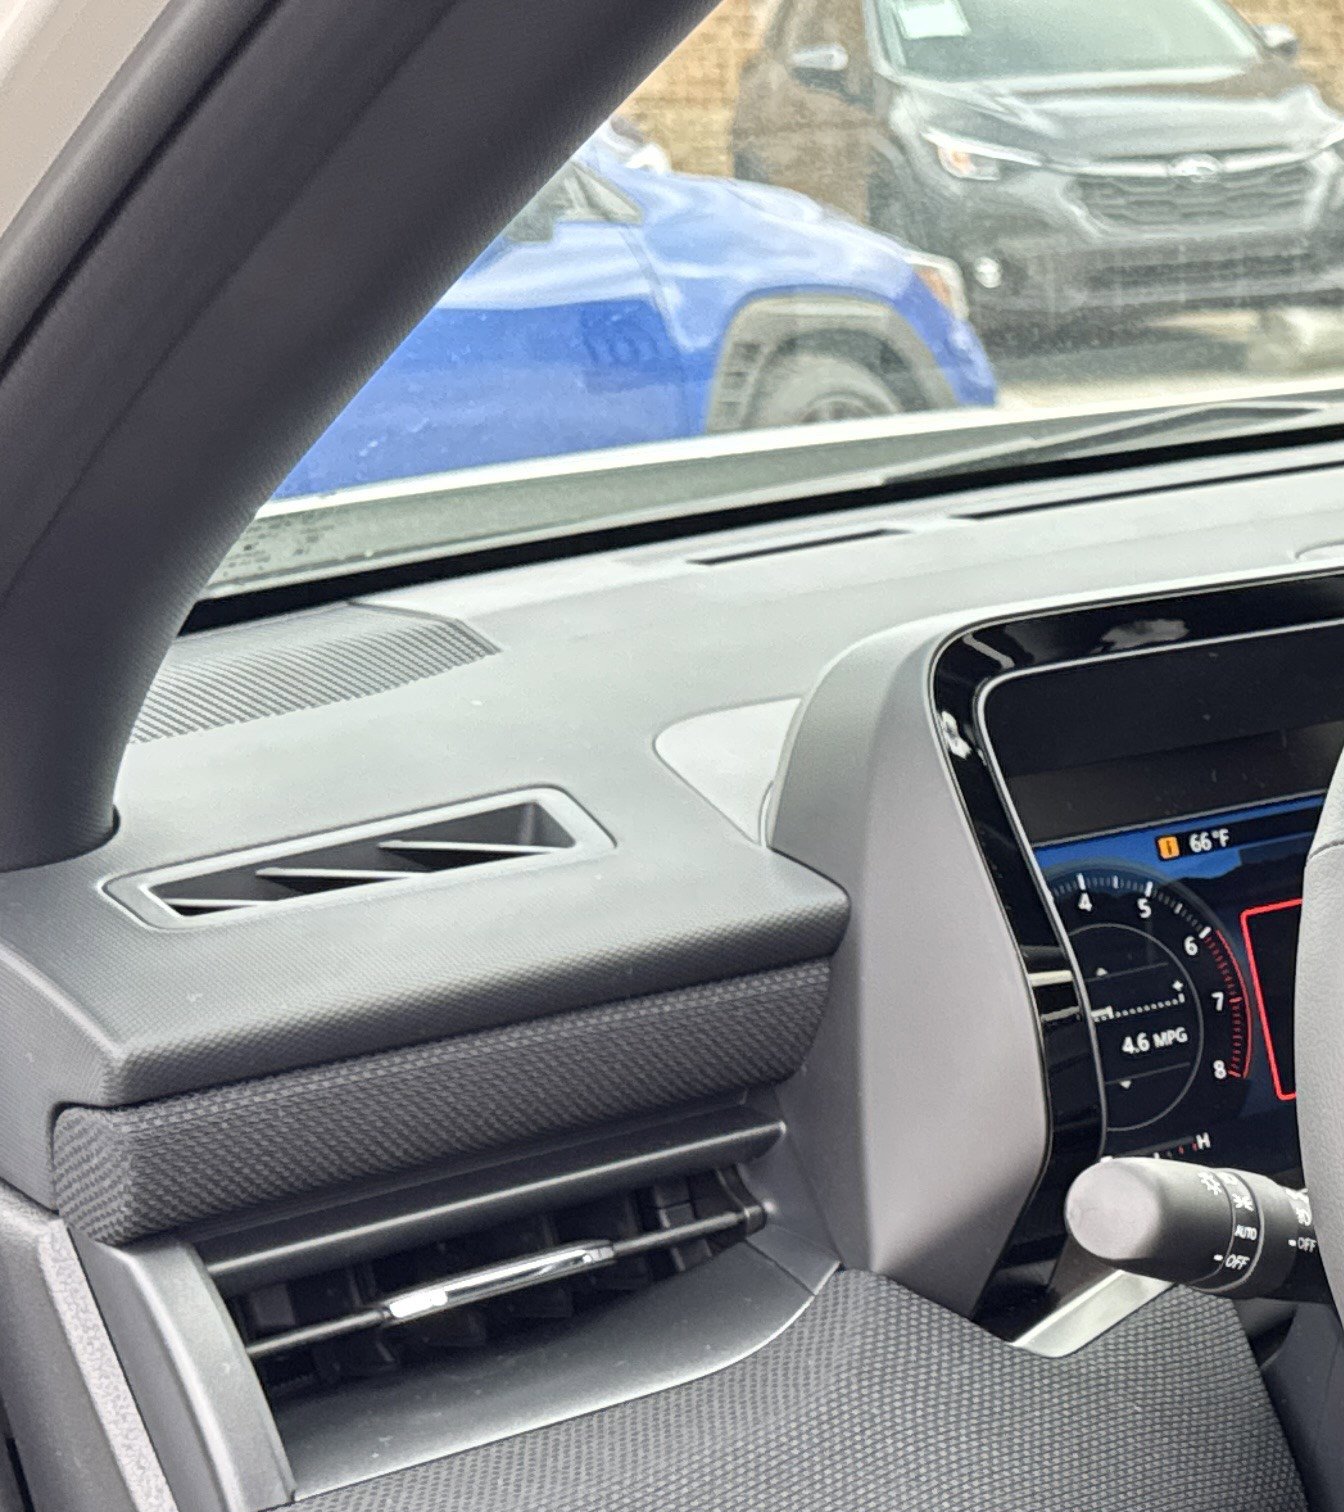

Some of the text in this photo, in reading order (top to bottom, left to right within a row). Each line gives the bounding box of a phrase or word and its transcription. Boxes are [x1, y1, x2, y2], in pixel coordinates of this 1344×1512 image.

[1189, 828, 1230, 854] 66°F
[1078, 892, 1093, 912] 4
[1137, 899, 1152, 919] 5
[1184, 936, 1199, 956] 6
[1211, 991, 1225, 1012] 7
[1121, 1027, 1189, 1055] 4.6 MPG
[1213, 1060, 1228, 1080] 8
[1195, 1132, 1211, 1150] H
[1234, 1224, 1258, 1241] AUTO
[1297, 1236, 1318, 1253] OFF
[1225, 1253, 1250, 1270] OFF
